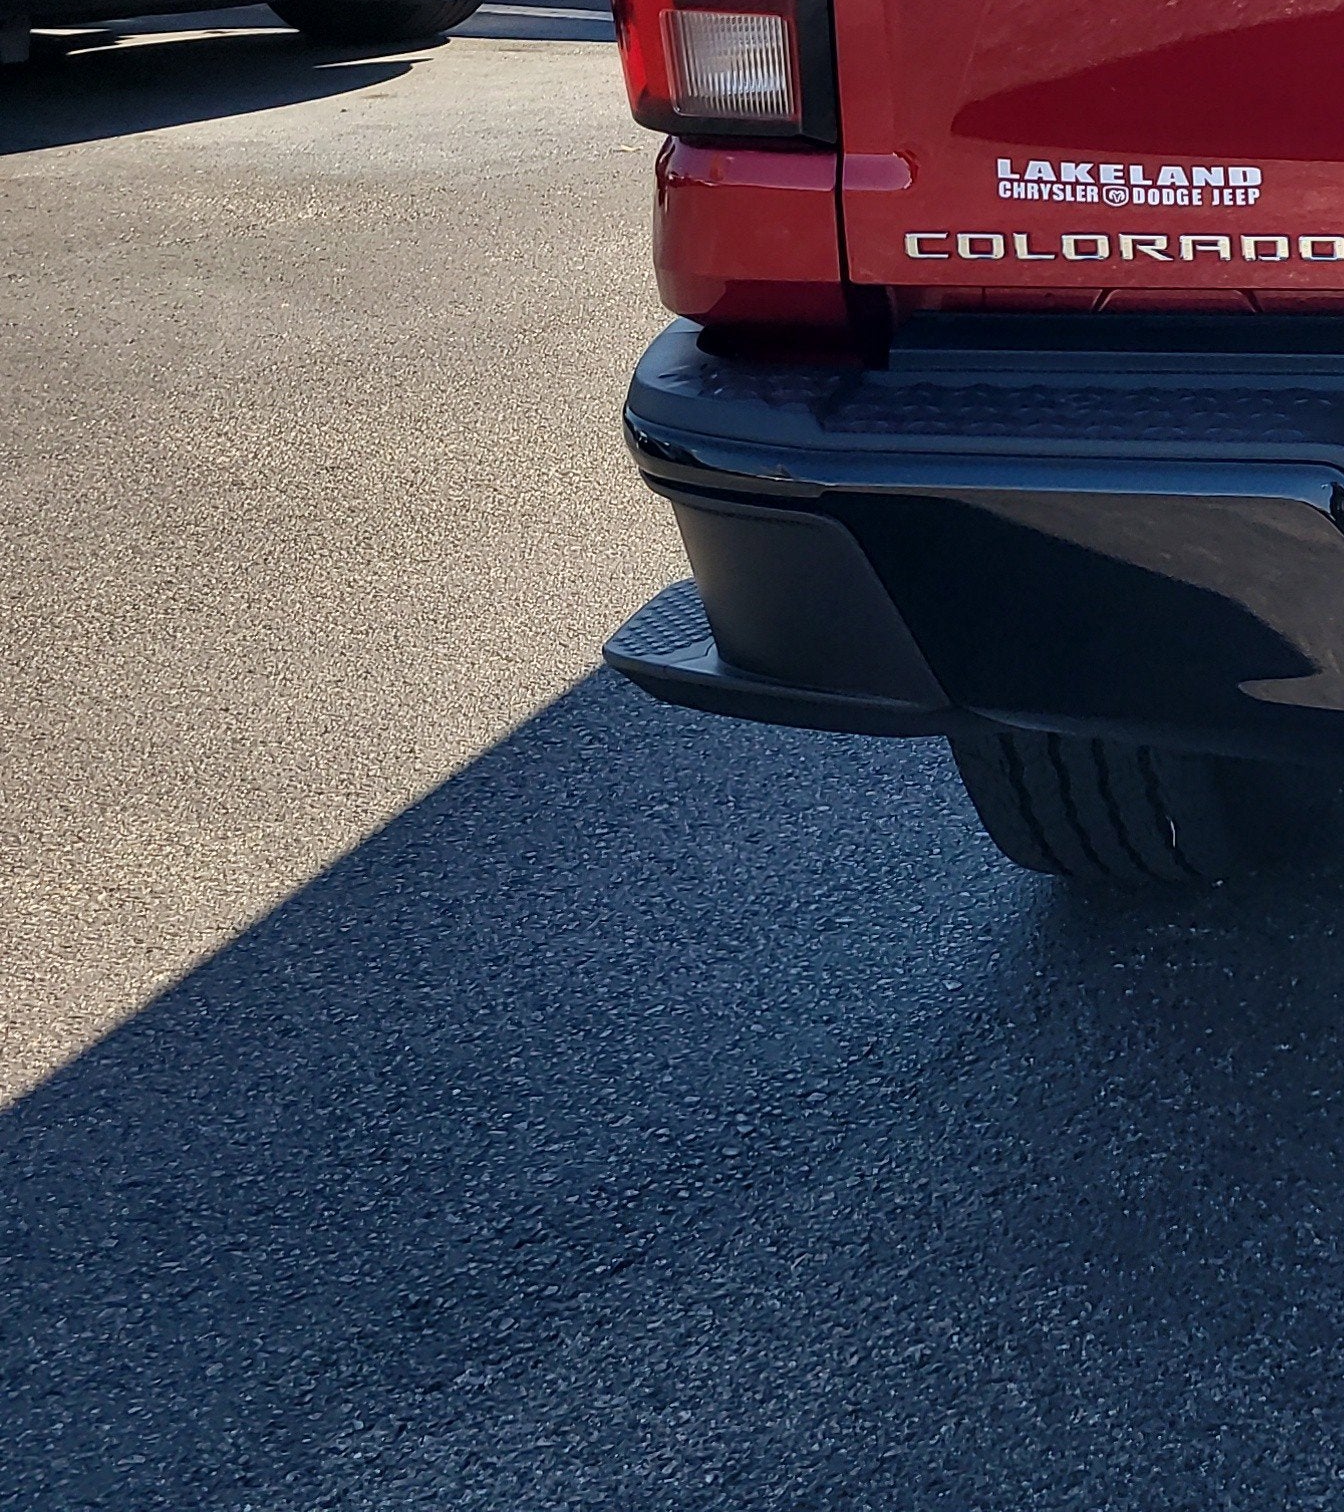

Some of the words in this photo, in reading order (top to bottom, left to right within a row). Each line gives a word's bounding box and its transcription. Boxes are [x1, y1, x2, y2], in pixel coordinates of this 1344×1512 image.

[997, 158, 1263, 186] LAKELAND
[998, 180, 1100, 203] CHRYSLER
[1133, 187, 1203, 206] DODGE
[1211, 188, 1261, 206] JEEP
